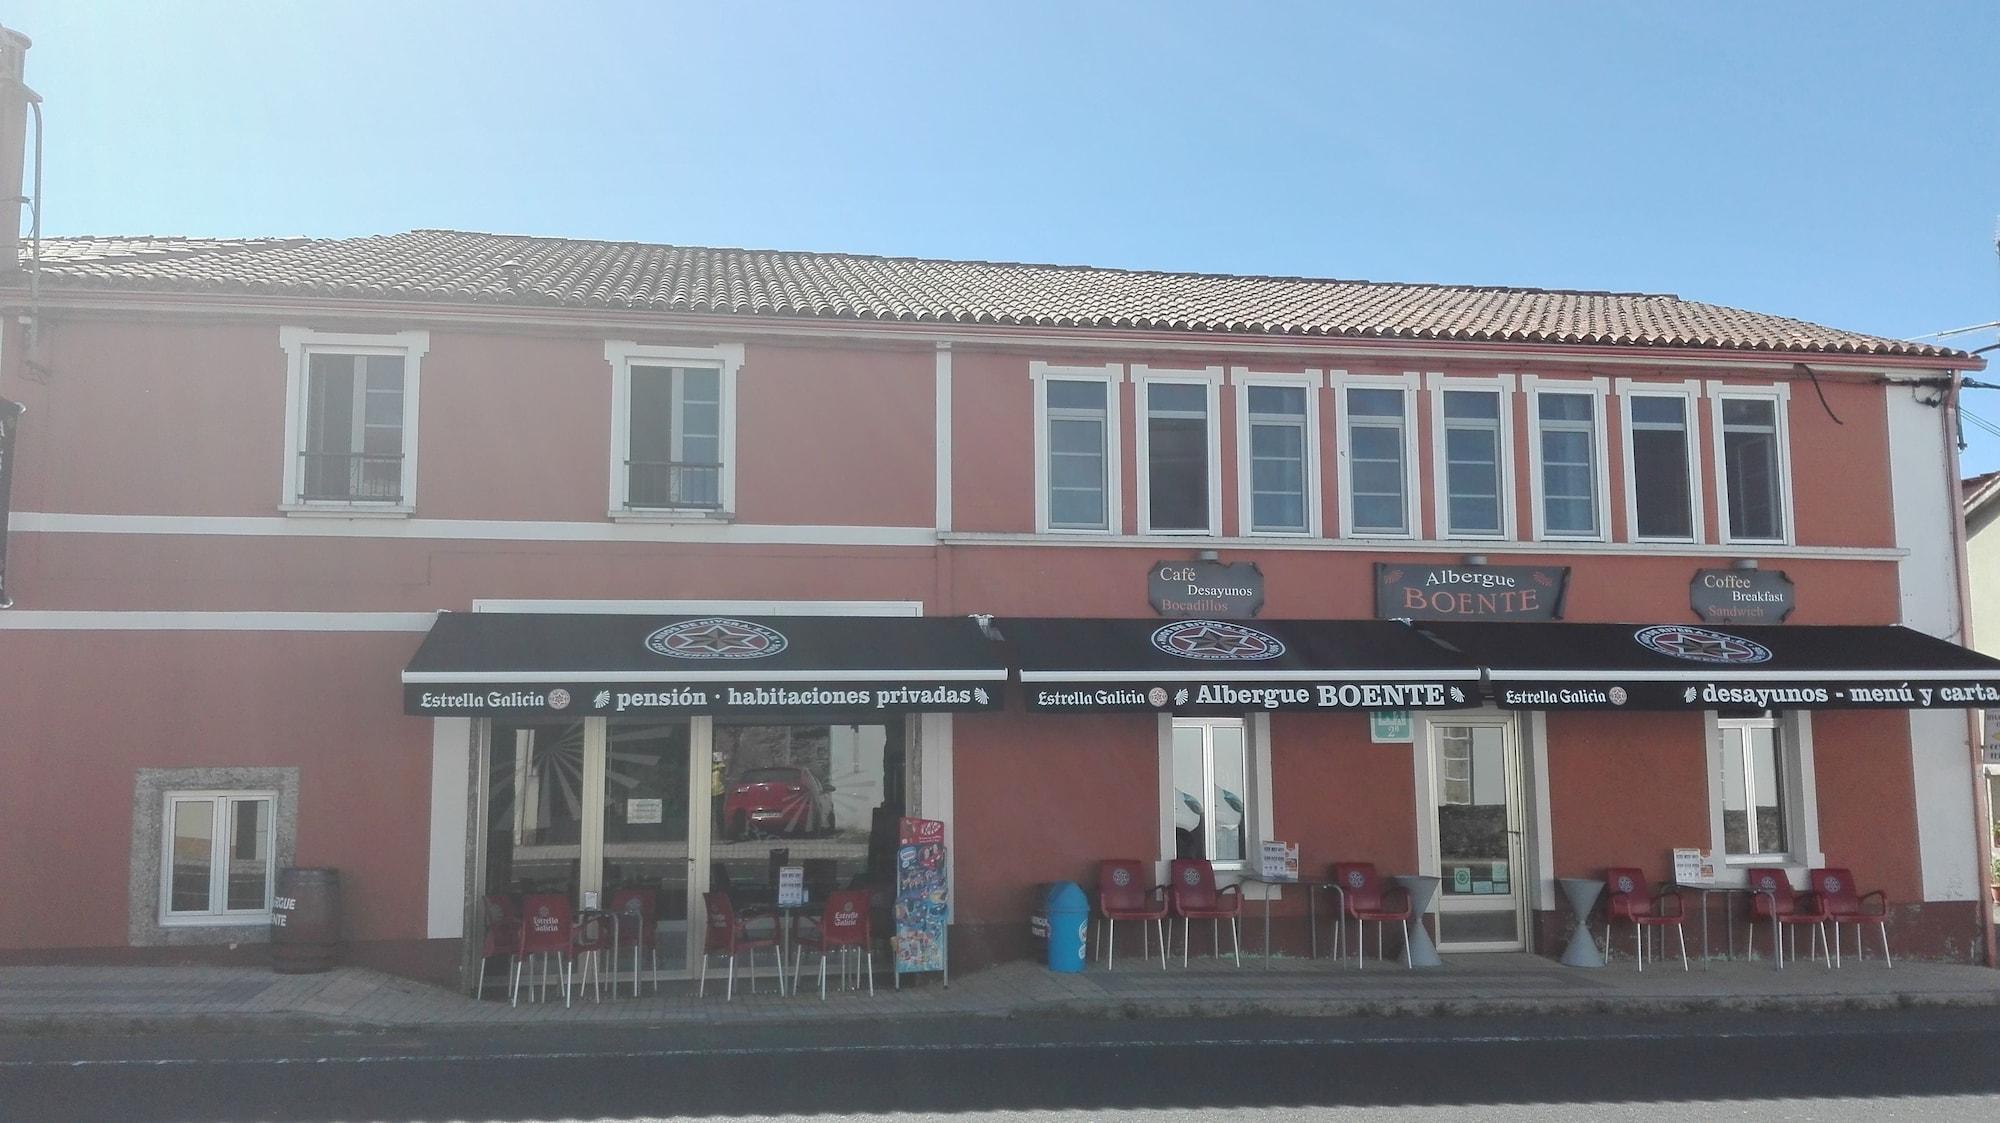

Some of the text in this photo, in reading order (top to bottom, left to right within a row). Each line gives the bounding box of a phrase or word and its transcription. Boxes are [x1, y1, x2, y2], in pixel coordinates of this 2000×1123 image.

[1160, 567, 1196, 581] Café
[1426, 570, 1516, 588] Albergue
[1704, 575, 1751, 589] Coffee
[1188, 584, 1253, 598] Desayunos
[1732, 591, 1784, 602] Breakfast
[1162, 599, 1229, 612] Bocadillos
[1403, 587, 1540, 614] BOENTE
[1708, 605, 1764, 617] Sandwich
[421, 691, 544, 708] Estrella Galicia
[616, 687, 707, 711] pensión
[728, 687, 870, 705] habitaciones
[876, 686, 971, 708] privadas
[1038, 689, 1145, 705] Estrella Galicia
[1196, 684, 1445, 709] Albergue BOENTE
[1506, 689, 1607, 704] Estrella Galicia
[1702, 684, 1829, 708] desayunos
[1851, 682, 1914, 702] menú
[1918, 689, 1933, 706] y
[1941, 683, 2000, 701] carta
